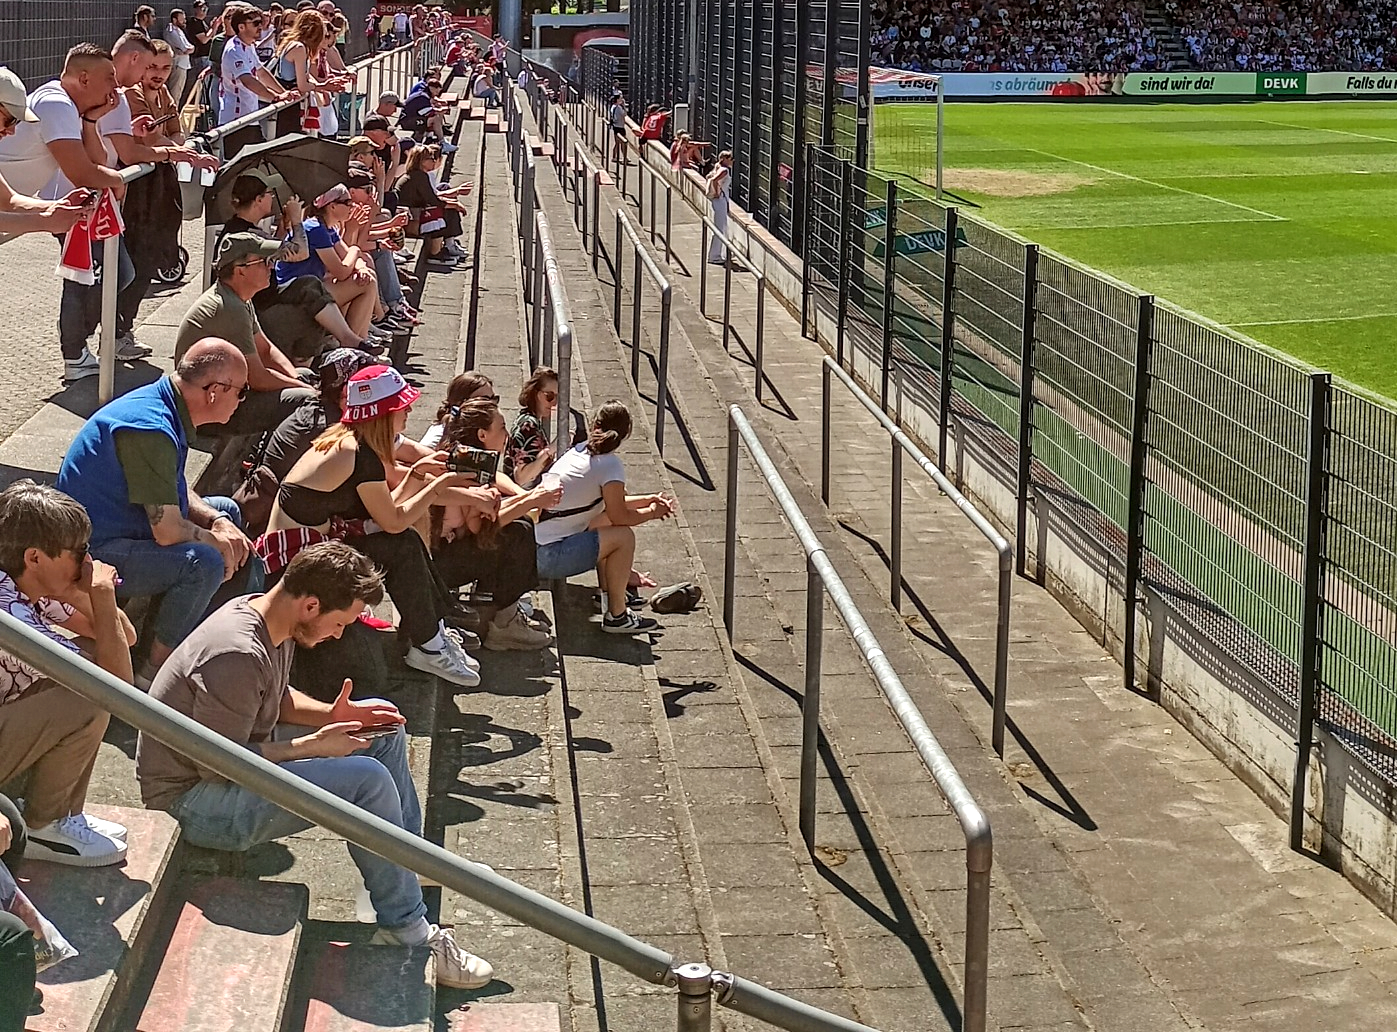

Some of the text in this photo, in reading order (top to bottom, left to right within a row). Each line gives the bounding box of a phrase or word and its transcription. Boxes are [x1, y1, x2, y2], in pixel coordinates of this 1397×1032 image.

[380, 5, 412, 13] SONDE
[1140, 76, 1215, 91] sind wir da!
[1263, 78, 1299, 89] DEVK
[1346, 76, 1375, 89] Falls
[1377, 76, 1392, 89] du
[344, 404, 378, 420] KÖLN
